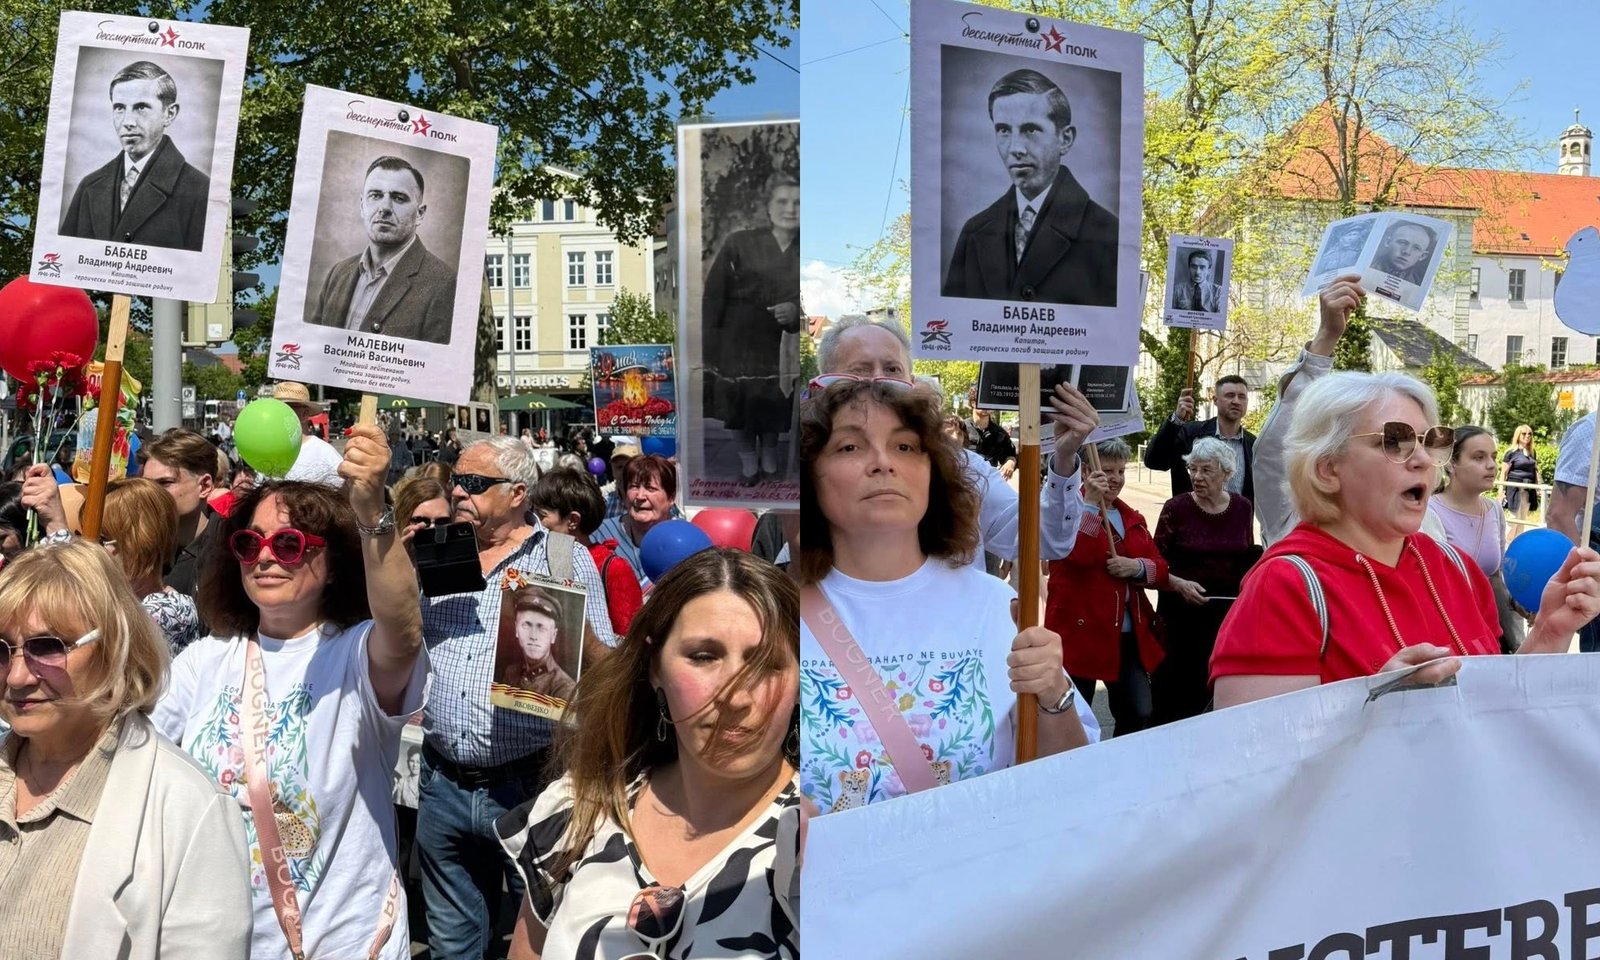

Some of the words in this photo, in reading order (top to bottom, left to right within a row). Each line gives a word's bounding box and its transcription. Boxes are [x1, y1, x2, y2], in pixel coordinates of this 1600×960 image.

[96, 20, 160, 46] бессмертный
[961, 12, 1044, 50] бессмертный
[346, 100, 412, 133] бессмертный
[104, 245, 148, 260] БАБАЕВ
[78, 254, 124, 271] Владимир
[125, 261, 173, 276] Андреевич
[1003, 306, 1056, 321] БАБАЕВ
[972, 320, 1027, 335] Владимир
[1029, 323, 1087, 339] Андреевич
[347, 335, 405, 354] МАЛЕВИЧ
[1014, 337, 1047, 346] Капитан,
[323, 345, 366, 360] Василий
[368, 353, 426, 369] Васильевич
[969, 345, 1009, 354] героически
[1011, 345, 1031, 354] погиб
[1032, 347, 1065, 355] защищая
[1065, 348, 1089, 358] родину
[818, 607, 902, 723] BOGNER
[920, 651, 935, 660] NE
[941, 649, 984, 662] BUVAYE
[250, 657, 267, 766] BOGNER
[514, 701, 549, 715] ЯКОВЕНКО
